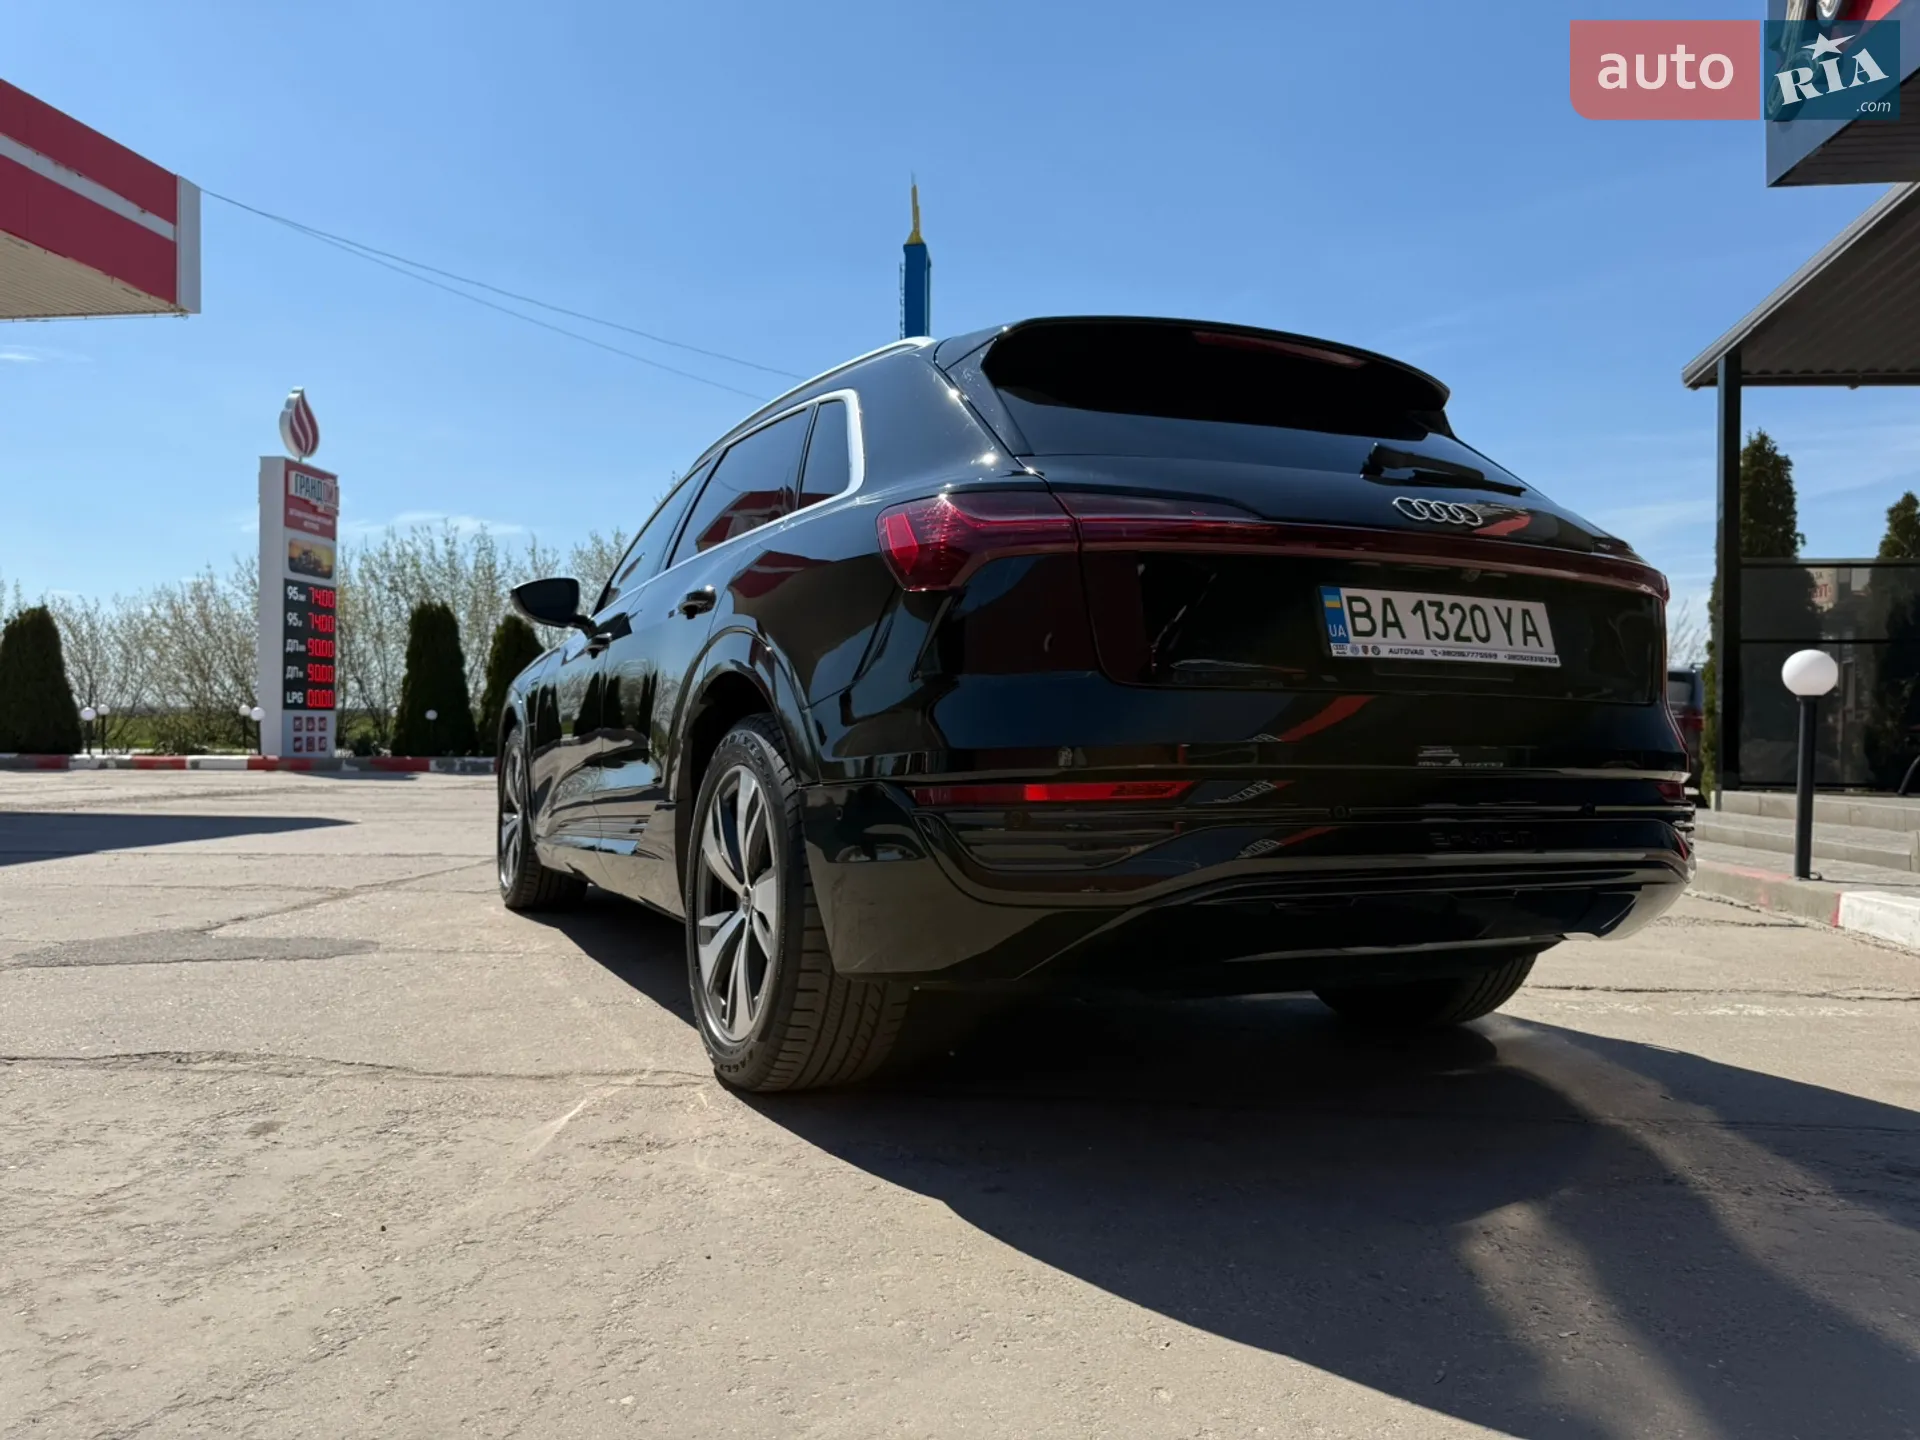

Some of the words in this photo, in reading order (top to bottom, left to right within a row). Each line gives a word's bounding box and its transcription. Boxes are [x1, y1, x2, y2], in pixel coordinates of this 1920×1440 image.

[1345, 595, 1406, 639] BA
[1411, 599, 1491, 643] 1320
[1493, 605, 1544, 648] YA
[1328, 623, 1347, 638] UA
[286, 691, 304, 704] LPG
